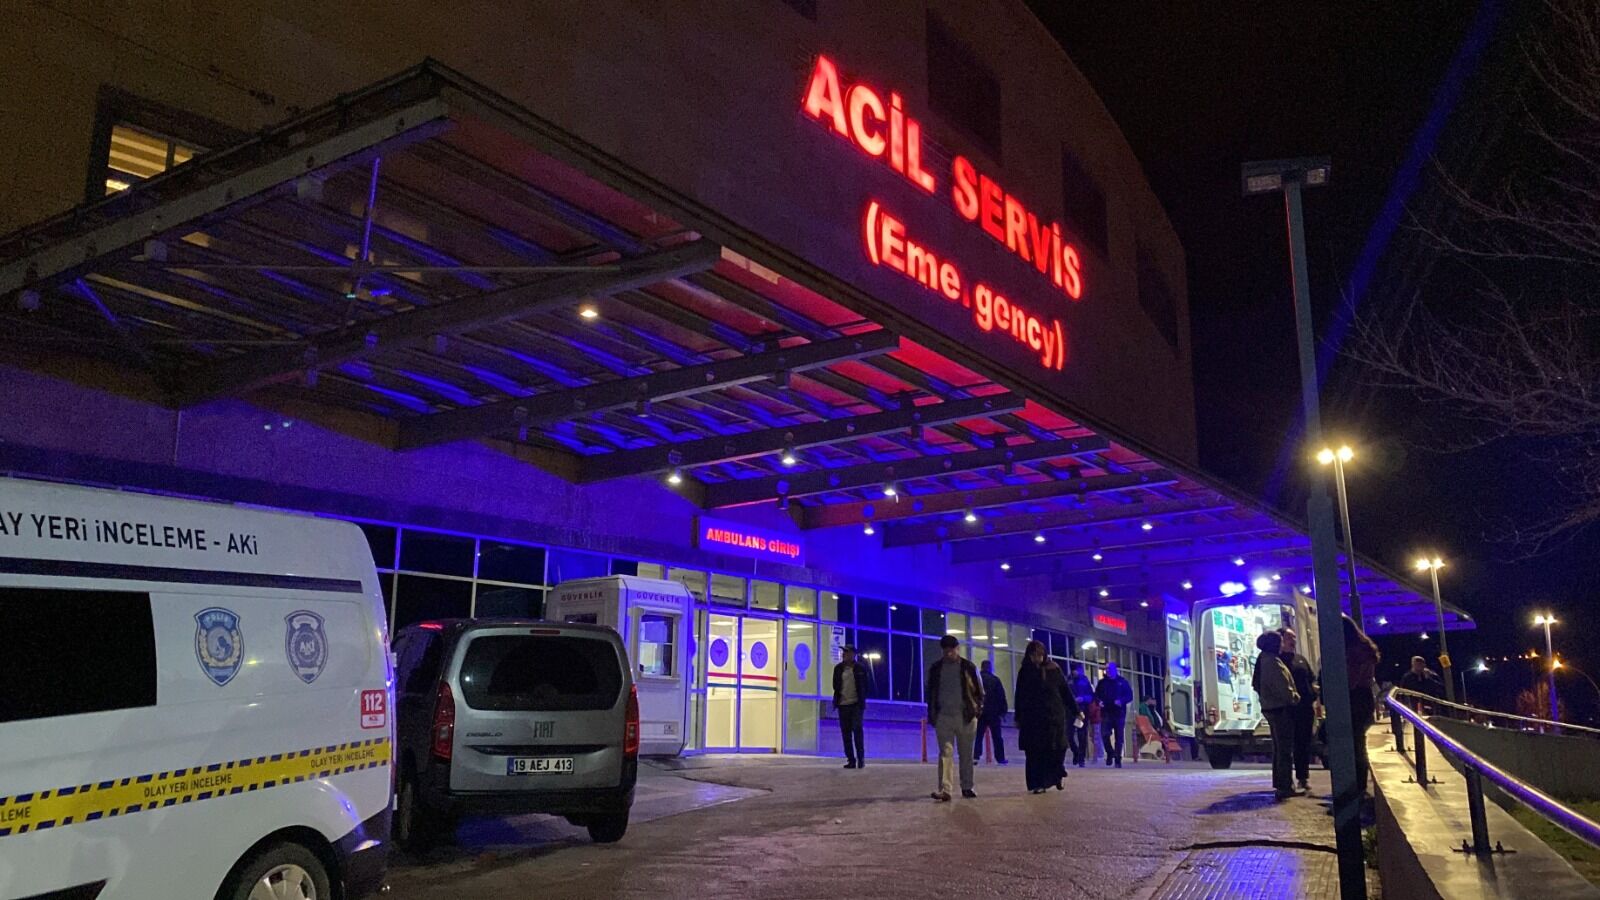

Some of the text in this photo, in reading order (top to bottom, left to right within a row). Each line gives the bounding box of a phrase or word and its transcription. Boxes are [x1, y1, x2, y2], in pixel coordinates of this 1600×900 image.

[706, 527, 767, 551] AMBULANS
[364, 692, 384, 712] 112
[533, 721, 556, 739] FIAT
[514, 759, 573, 772] 19 AEJ 413
